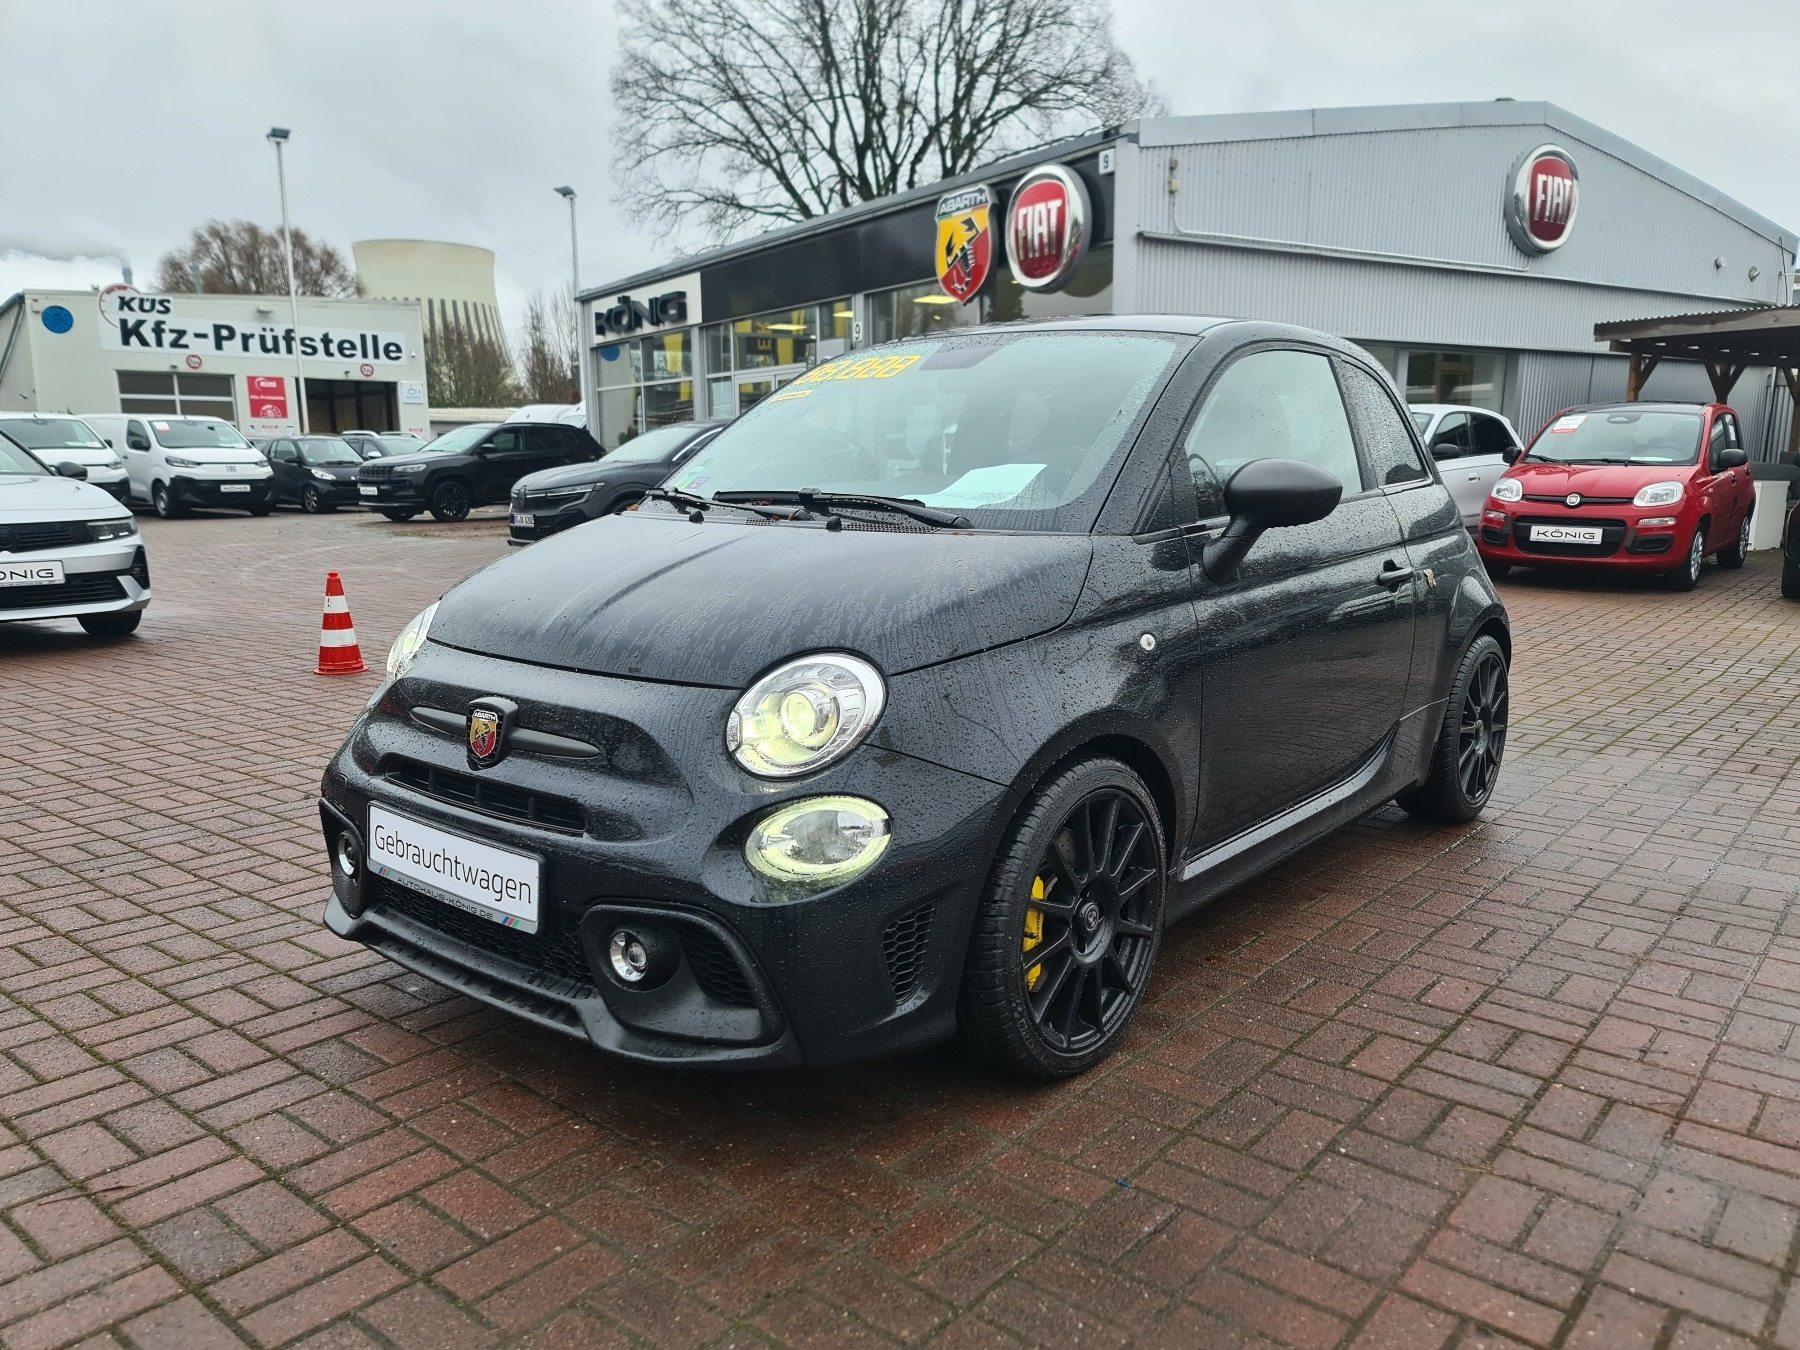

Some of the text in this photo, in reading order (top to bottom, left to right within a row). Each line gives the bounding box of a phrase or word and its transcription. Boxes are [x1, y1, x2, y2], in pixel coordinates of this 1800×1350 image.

[939, 191, 987, 215] ABARTH
[1534, 173, 1573, 225] FIAT
[1017, 199, 1063, 261] FIAT
[118, 296, 172, 315] KÜS
[594, 291, 687, 336] KÖNIG
[119, 318, 403, 361] Kfz-Prüfstelle
[1536, 528, 1596, 540] KÖNIG
[374, 824, 532, 904] Gebrauchtwagen
